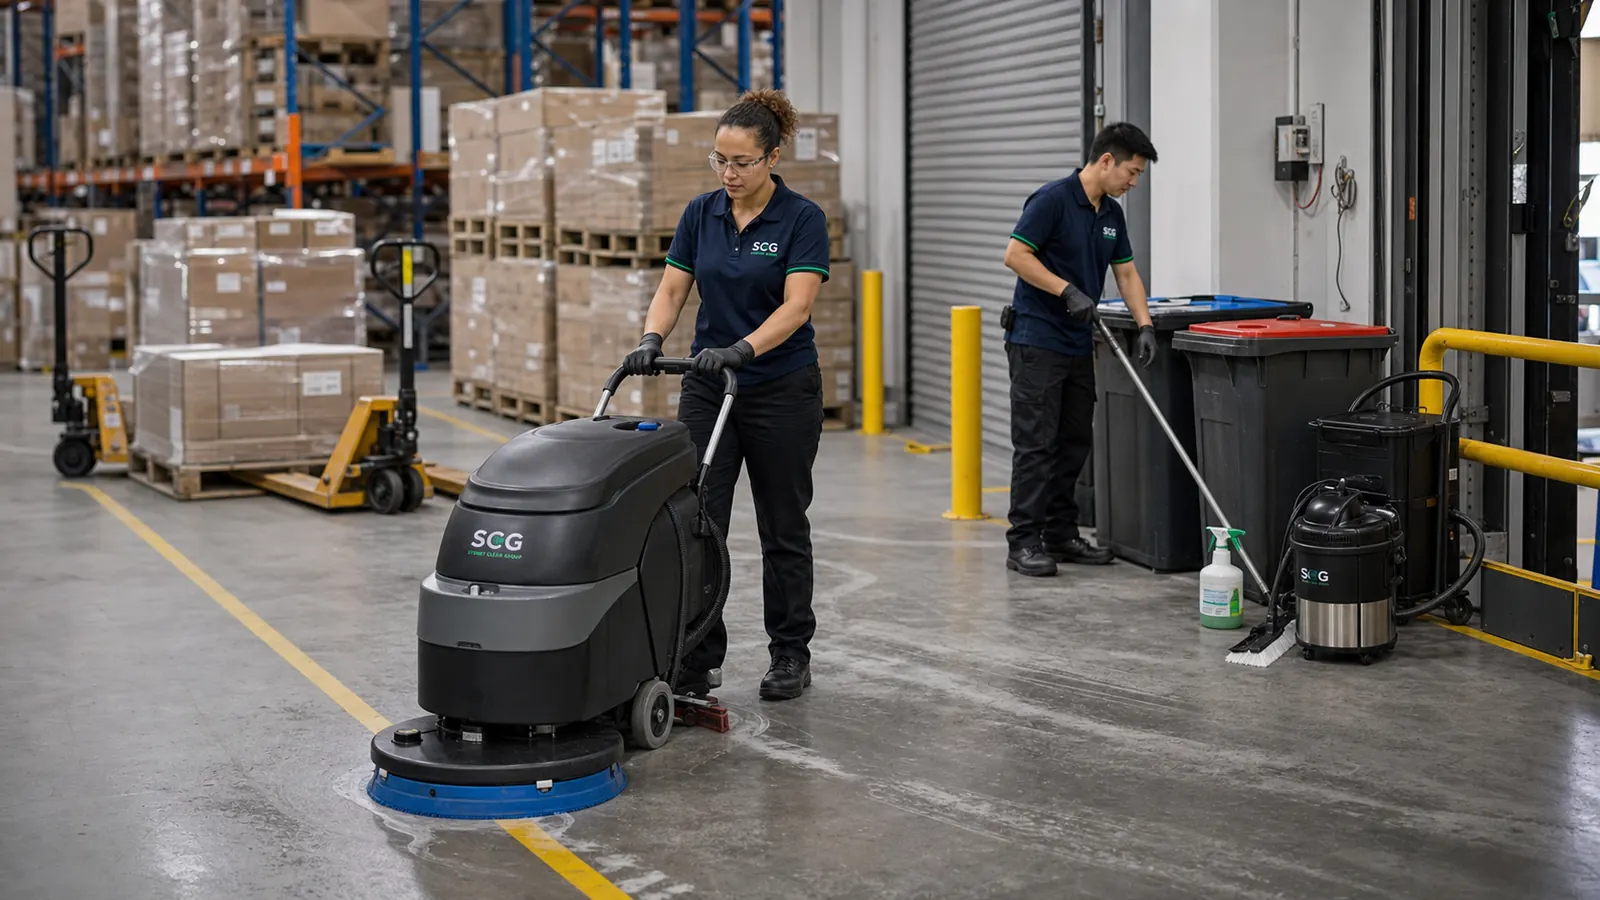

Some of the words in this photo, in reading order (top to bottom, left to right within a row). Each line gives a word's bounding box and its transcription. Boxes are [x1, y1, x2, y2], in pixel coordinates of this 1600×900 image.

[1103, 226, 1116, 237] SCG
[752, 241, 778, 252] SCG
[471, 529, 523, 551] SCG
